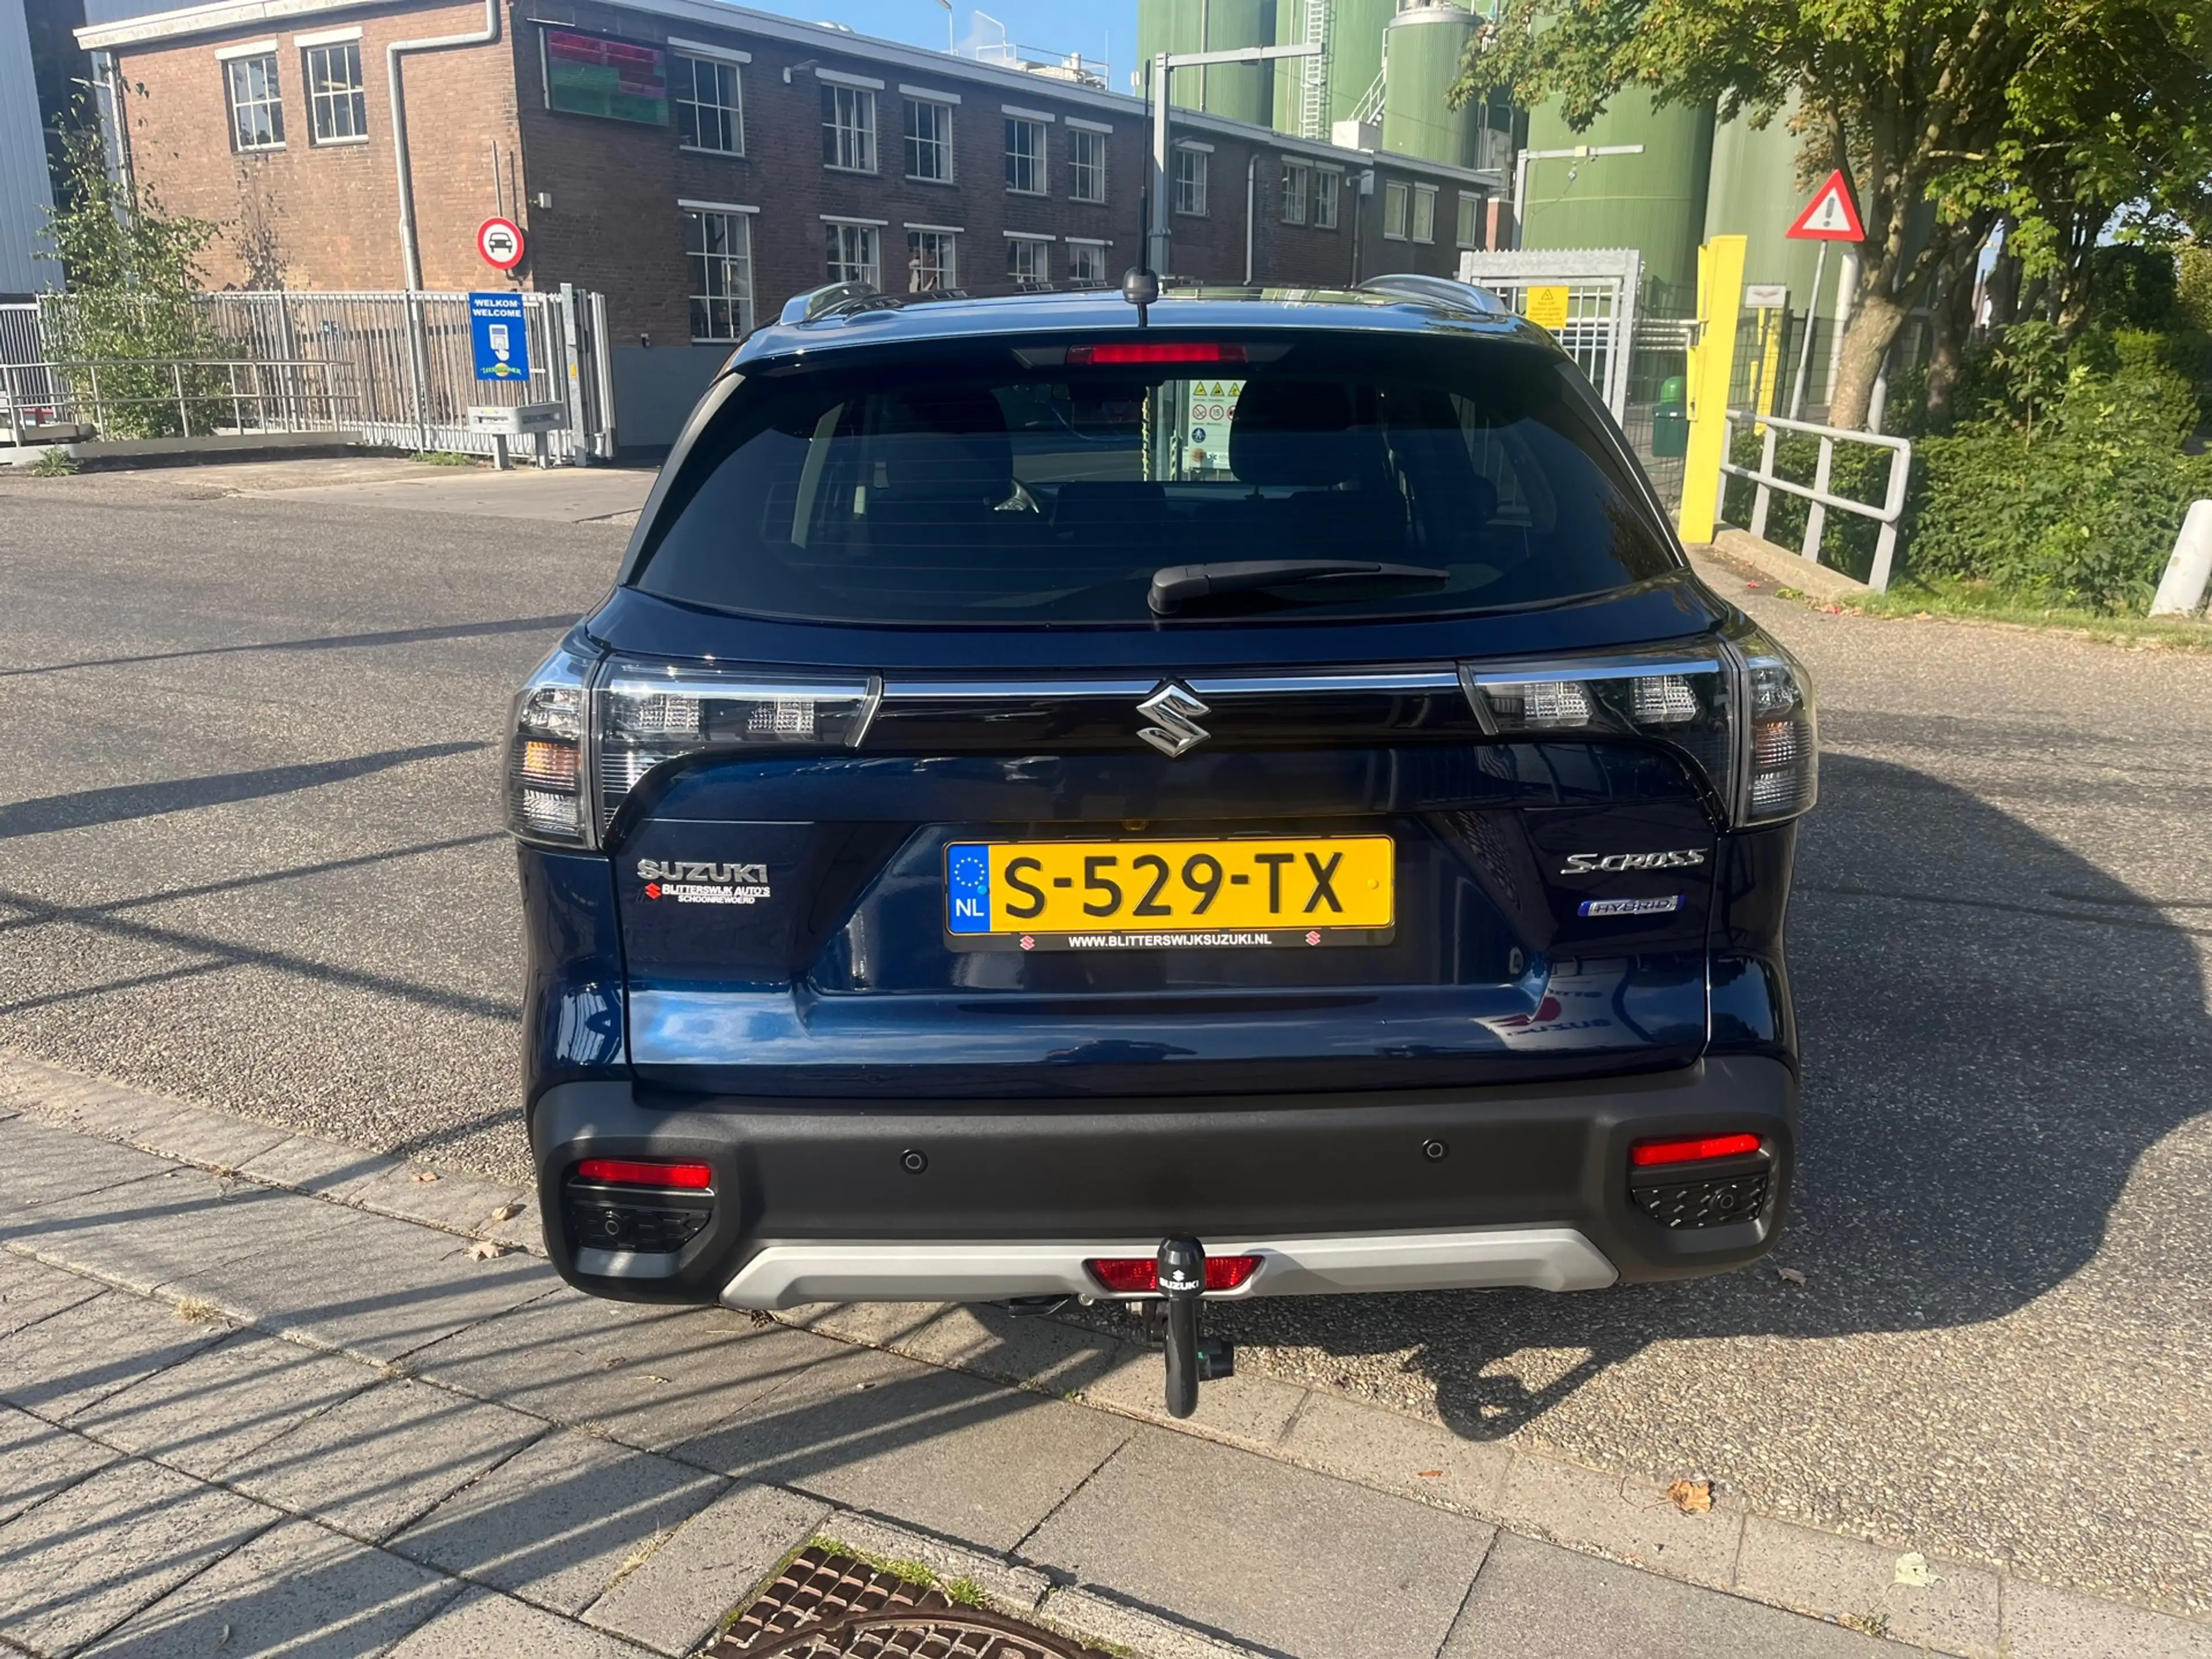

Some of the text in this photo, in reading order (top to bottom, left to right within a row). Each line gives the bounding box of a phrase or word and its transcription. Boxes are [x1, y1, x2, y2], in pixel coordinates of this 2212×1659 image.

[475, 299, 517, 307] WELKOM
[472, 309, 521, 317] WELCOME
[637, 858, 768, 883] SUZUKI
[662, 884, 770, 895] BLITTERSWIJK AUTO'S
[956, 851, 1344, 919] NL S-529-TX
[677, 895, 756, 904] SCHOONREWOERD
[1593, 899, 1673, 914] HYBRID
[1068, 933, 1272, 948] WWW.BLITTERSWIJKSUZUKI.NL
[1159, 1277, 1199, 1290] SUZUKI
